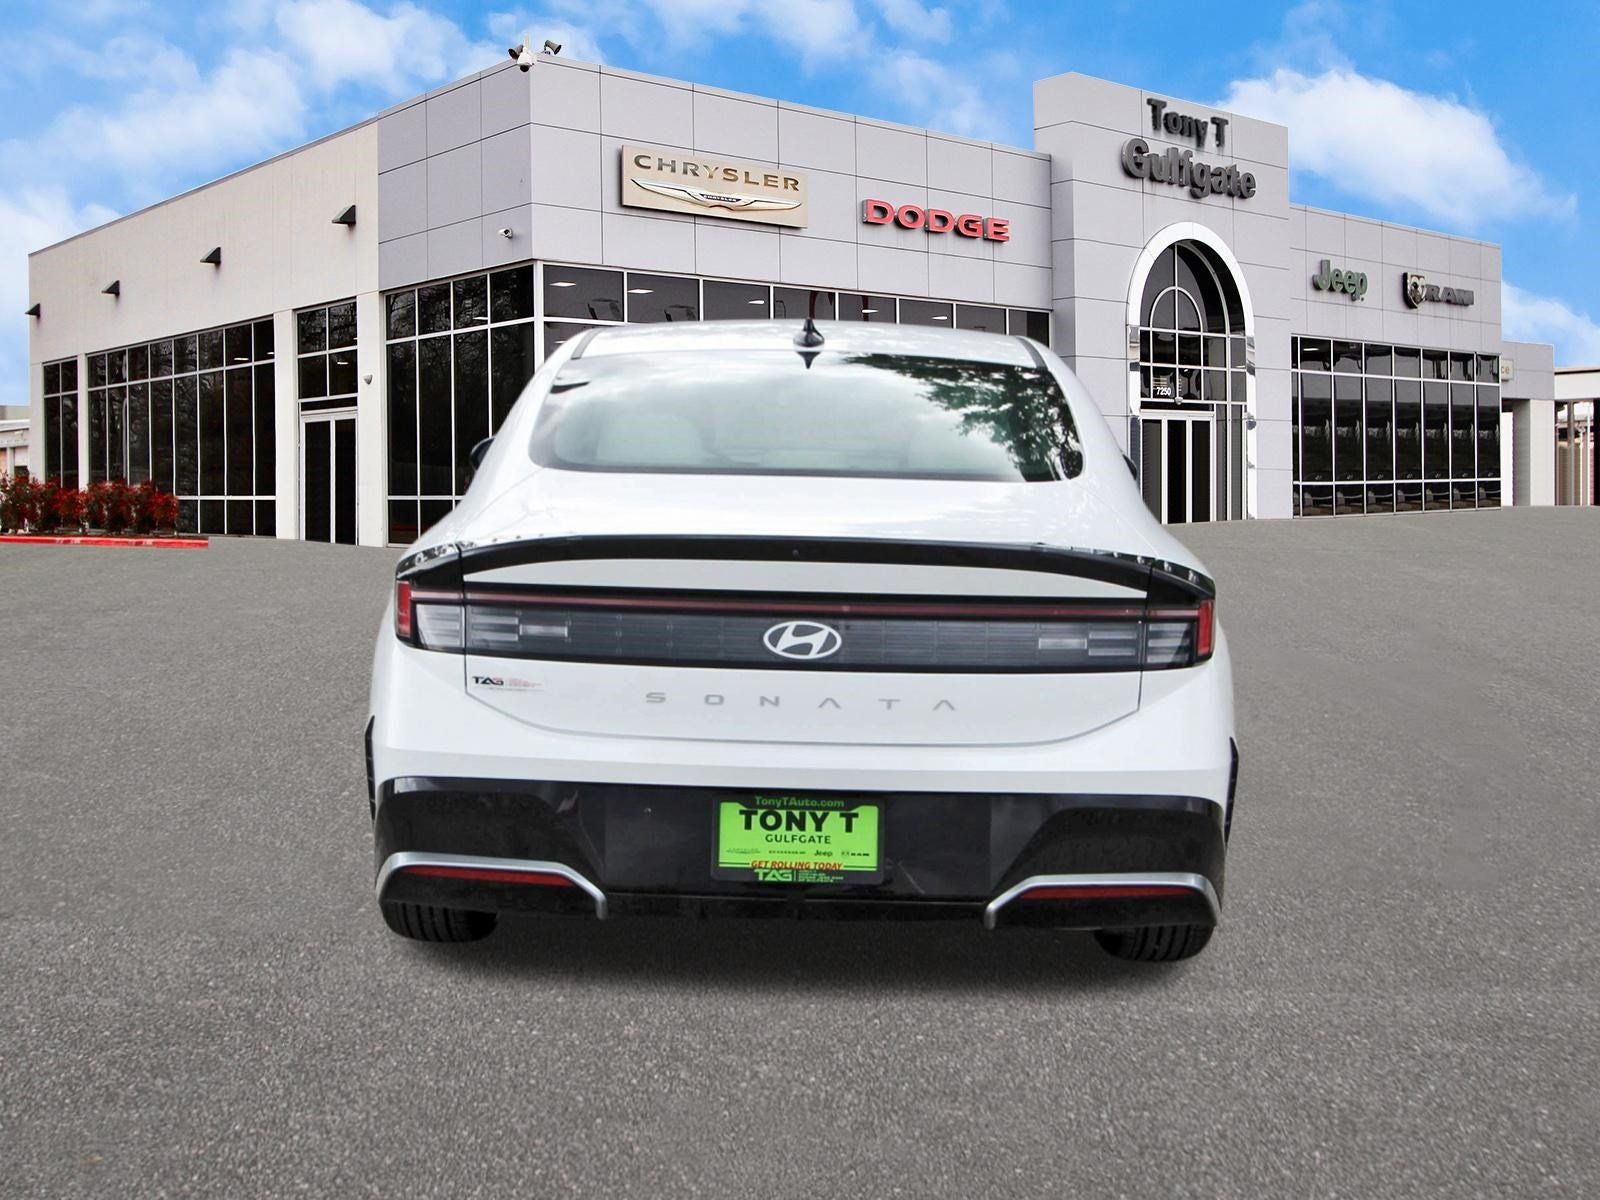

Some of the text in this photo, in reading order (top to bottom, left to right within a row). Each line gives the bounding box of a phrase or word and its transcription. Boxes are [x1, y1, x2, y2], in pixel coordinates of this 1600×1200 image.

[1146, 98, 1229, 147] Tony T
[634, 154, 799, 191] CHRYSLER
[1121, 138, 1256, 199] Gulfgate
[862, 198, 1010, 242] DODGE
[1312, 259, 1368, 302] Jeep
[1425, 283, 1474, 307] RAM
[1156, 387, 1172, 396] 7250
[645, 691, 956, 711] SONATA
[754, 796, 845, 808] TonyTAuto.com
[739, 809, 859, 833] TONY T
[765, 833, 831, 845] GULFGATE
[751, 860, 843, 871] GET ROLLING TODAY
[754, 868, 793, 882] TAG
